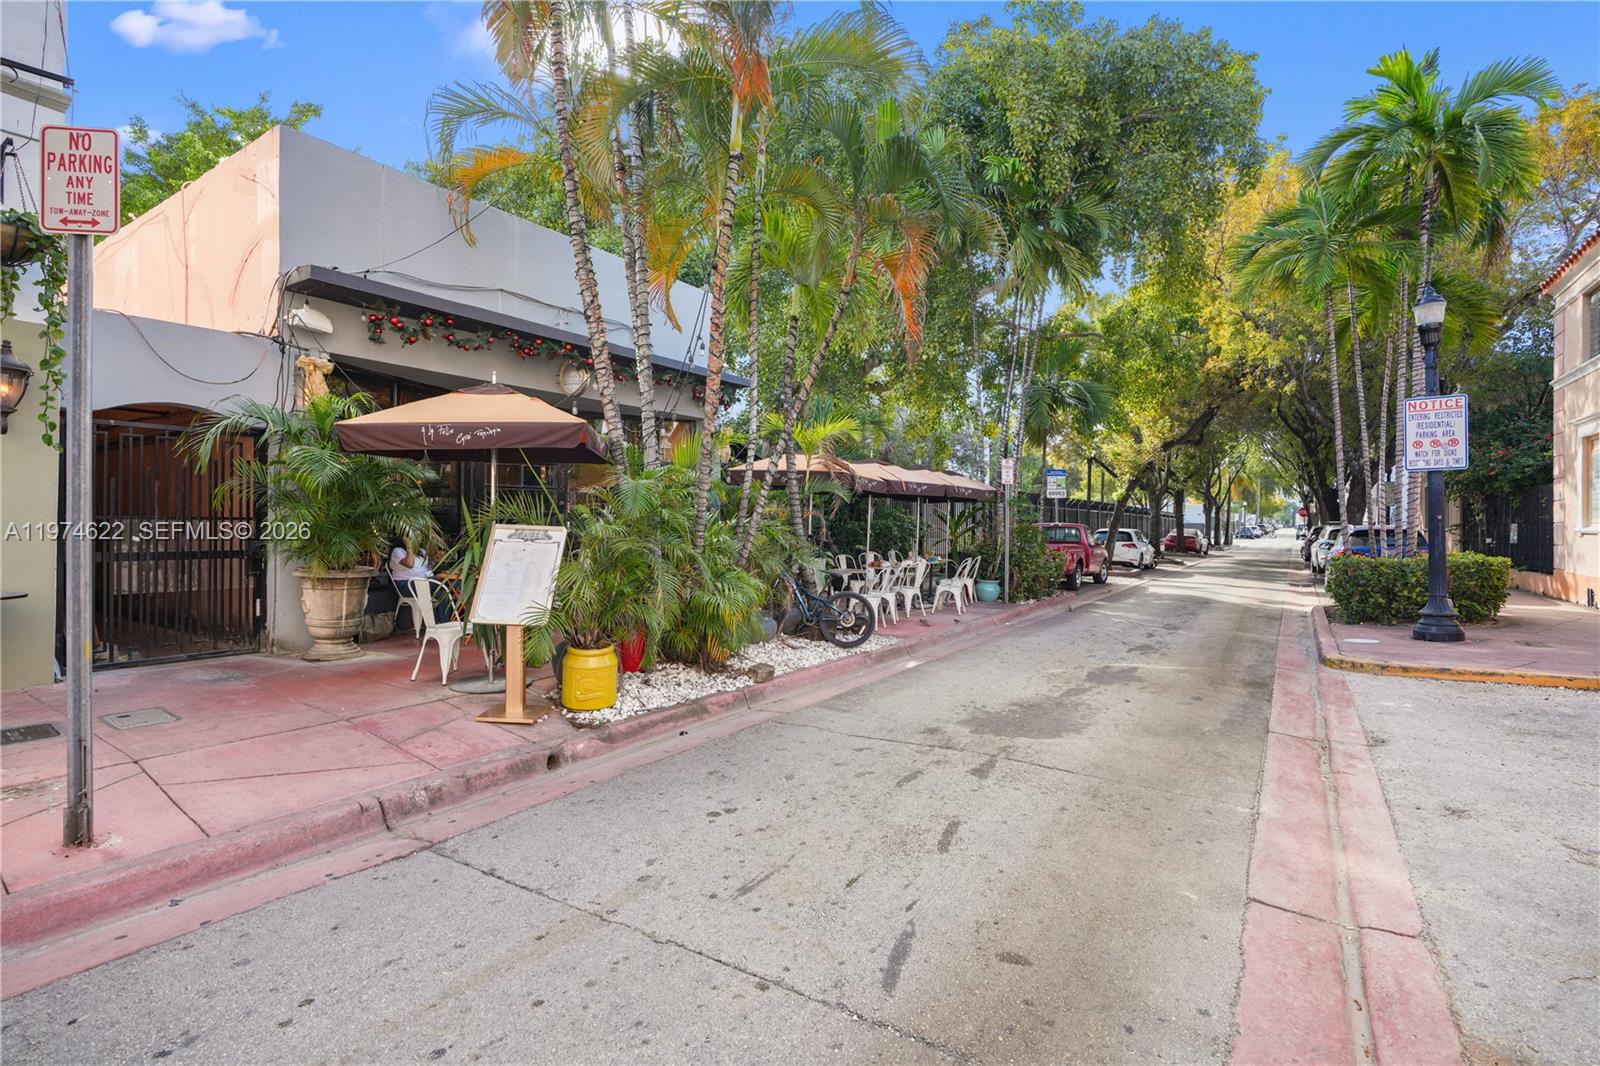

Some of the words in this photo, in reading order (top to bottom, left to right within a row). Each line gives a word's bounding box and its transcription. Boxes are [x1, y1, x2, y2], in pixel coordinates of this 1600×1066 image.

[68, 132, 92, 151] NO
[47, 152, 112, 174] PARKING
[66, 175, 94, 189] ANY
[66, 191, 94, 206] TIME
[1408, 398, 1463, 411] NOTICE
[1408, 413, 1430, 421] ENTERING
[1434, 411, 1463, 419] RESTRICTED
[1416, 431, 1438, 439] PARKING
[1431, 449, 1440, 457] FOR
